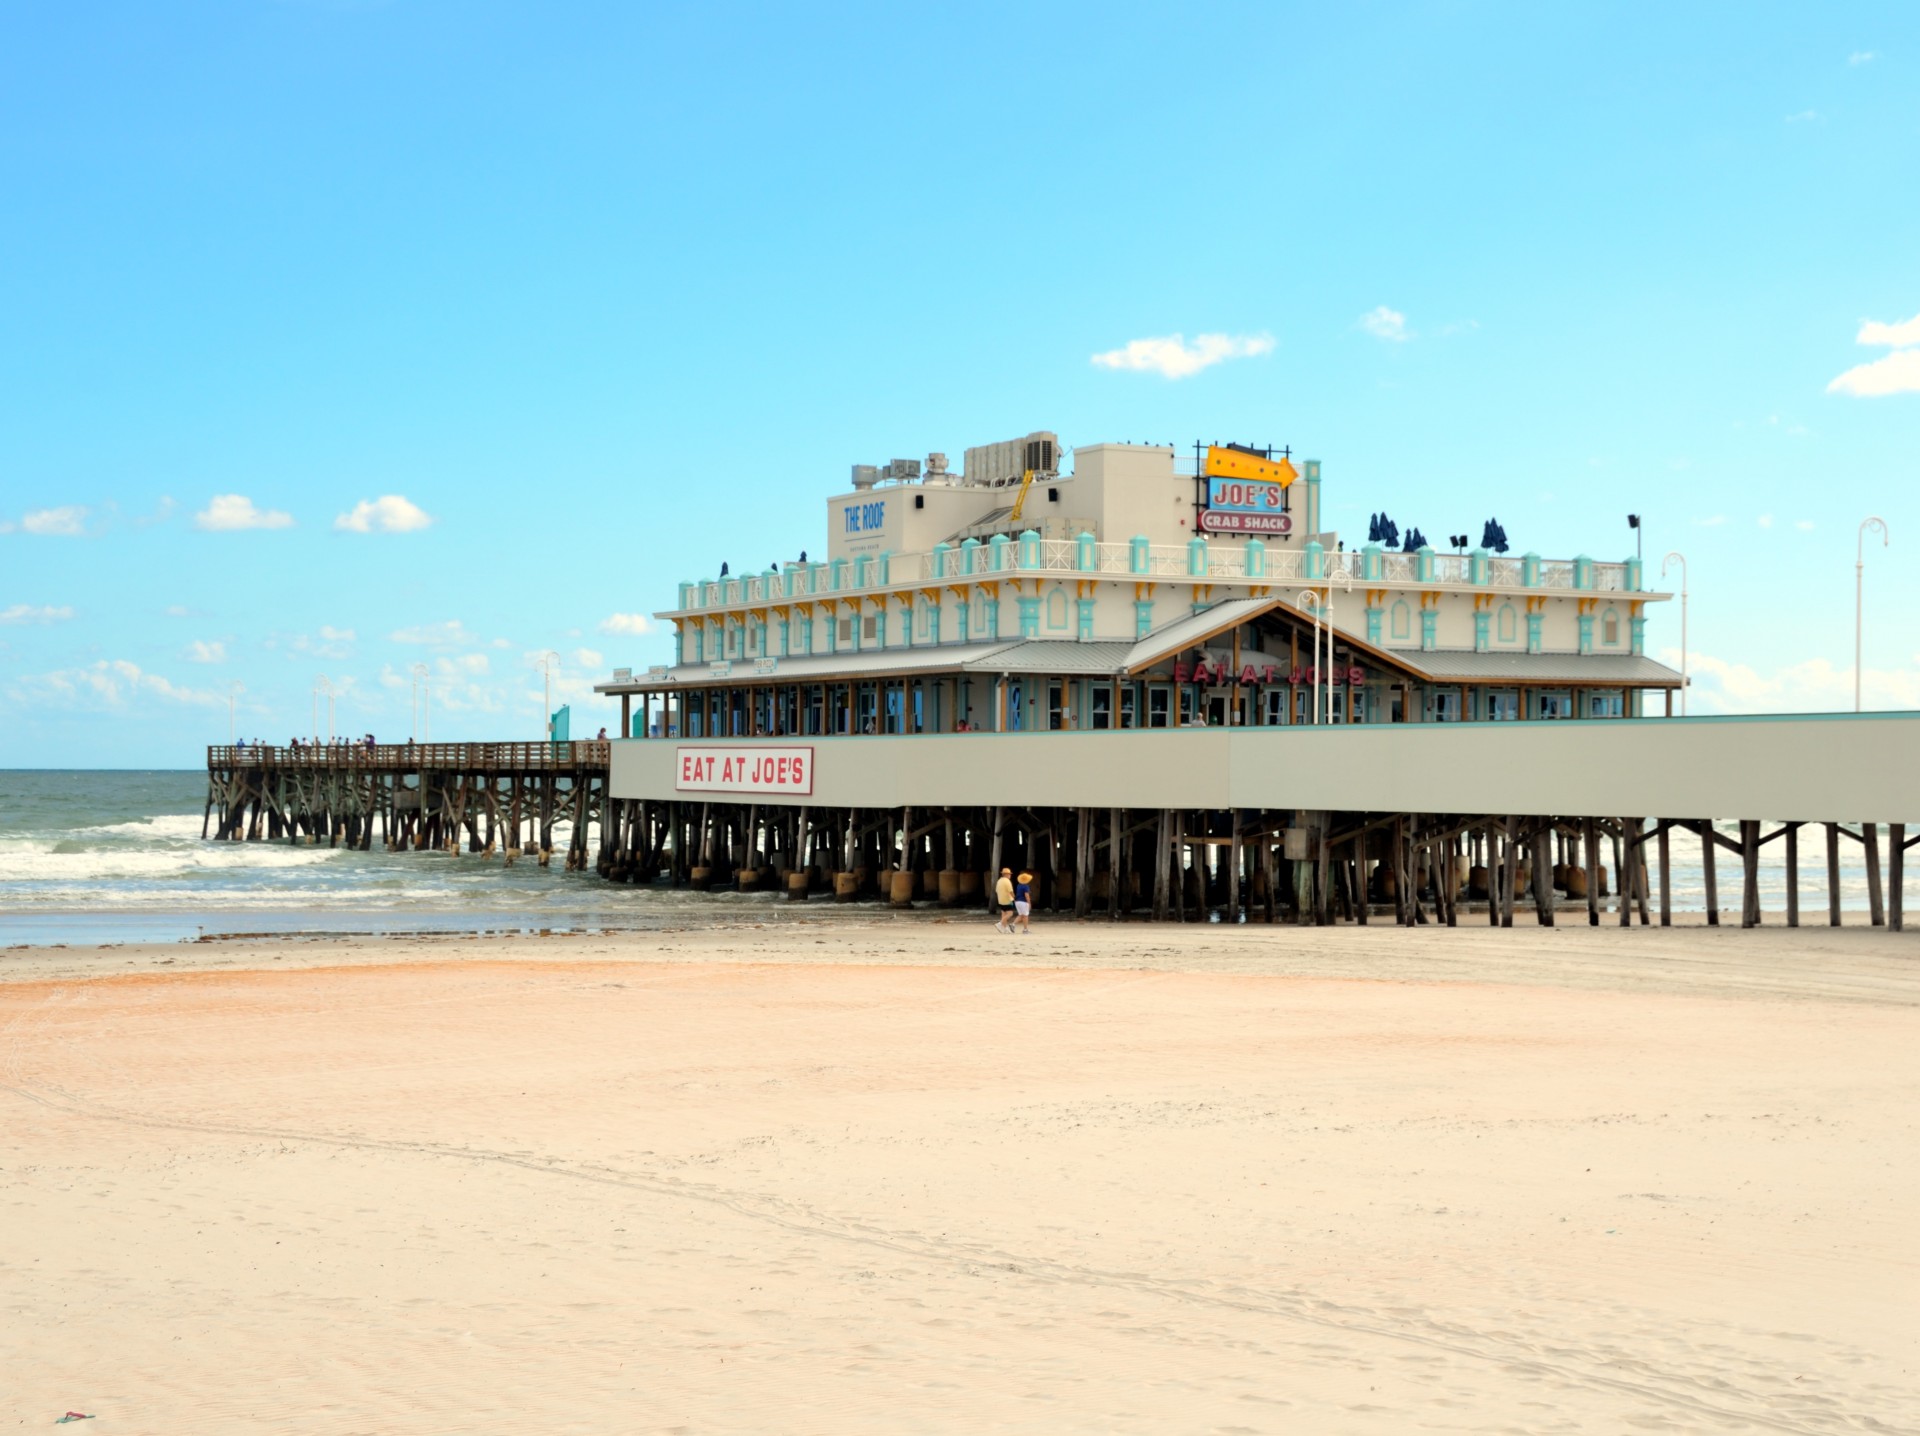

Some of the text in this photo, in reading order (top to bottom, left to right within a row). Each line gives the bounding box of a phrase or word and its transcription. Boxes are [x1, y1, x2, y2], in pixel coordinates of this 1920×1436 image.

[1213, 482, 1280, 507] JOE'S
[844, 501, 885, 533] THE ROOF
[1205, 515, 1285, 530] CRAB SHACK
[1174, 663, 1226, 683] EAT
[1240, 664, 1277, 683] AT
[683, 757, 803, 784] EAT AT JOE'S
